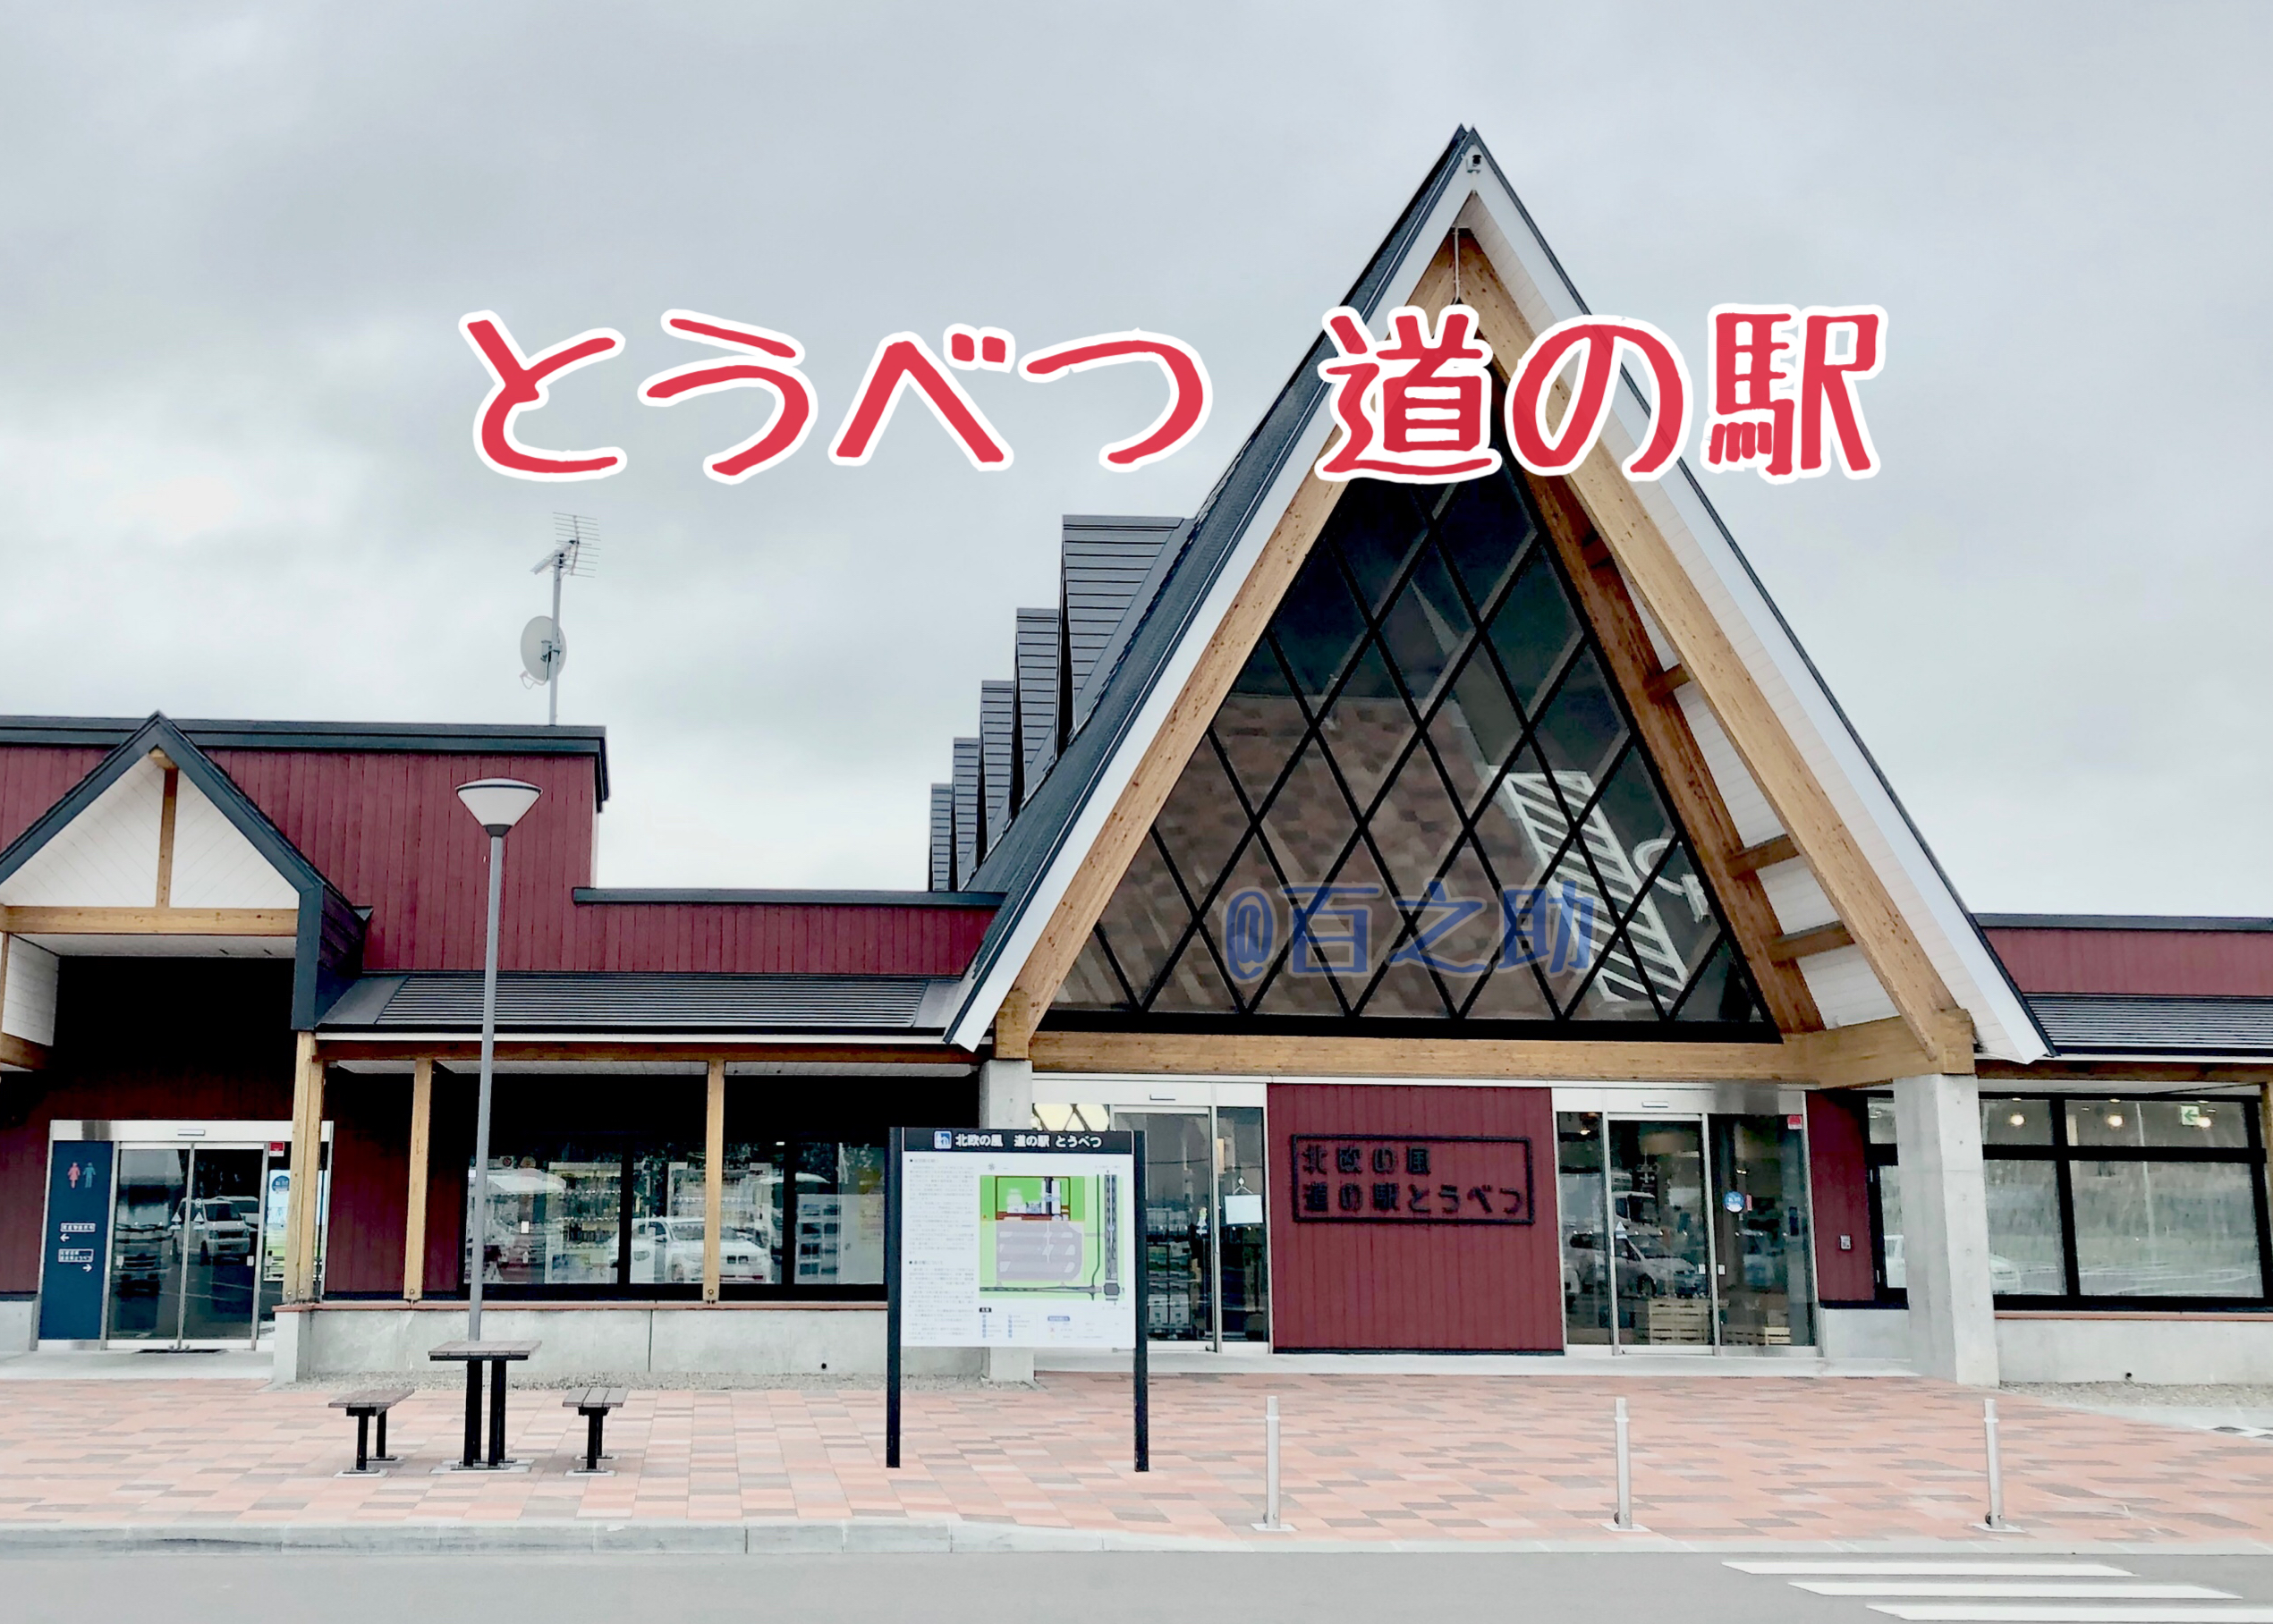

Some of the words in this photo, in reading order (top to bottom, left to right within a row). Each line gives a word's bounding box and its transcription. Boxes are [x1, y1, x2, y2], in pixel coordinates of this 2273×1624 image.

[954, 1133, 1004, 1147] 北欧の風
[1014, 1134, 1050, 1147] 道の駅
[1056, 1135, 1102, 1147] とうべつ
[1302, 1145, 1430, 1175] 北欧の風
[1302, 1181, 1522, 1214] 道の駅とうべつ
